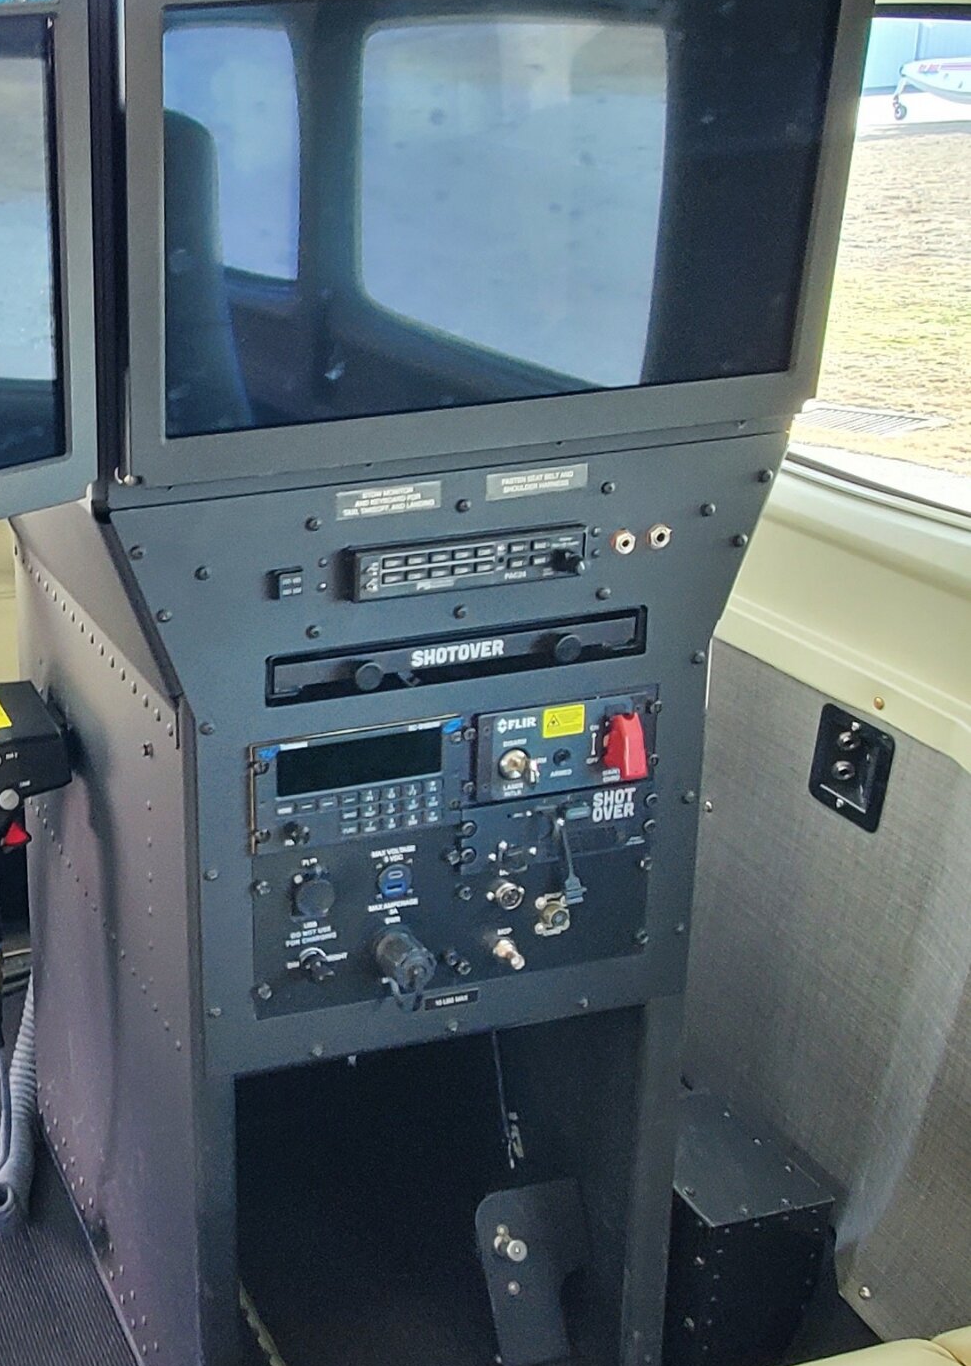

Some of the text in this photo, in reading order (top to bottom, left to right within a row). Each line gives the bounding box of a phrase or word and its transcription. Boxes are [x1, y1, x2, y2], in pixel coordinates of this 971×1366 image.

[411, 639, 504, 667] SHOTOVER
[508, 717, 537, 731] FLIR
[593, 787, 637, 808] SHOT
[592, 802, 635, 823] OVER
